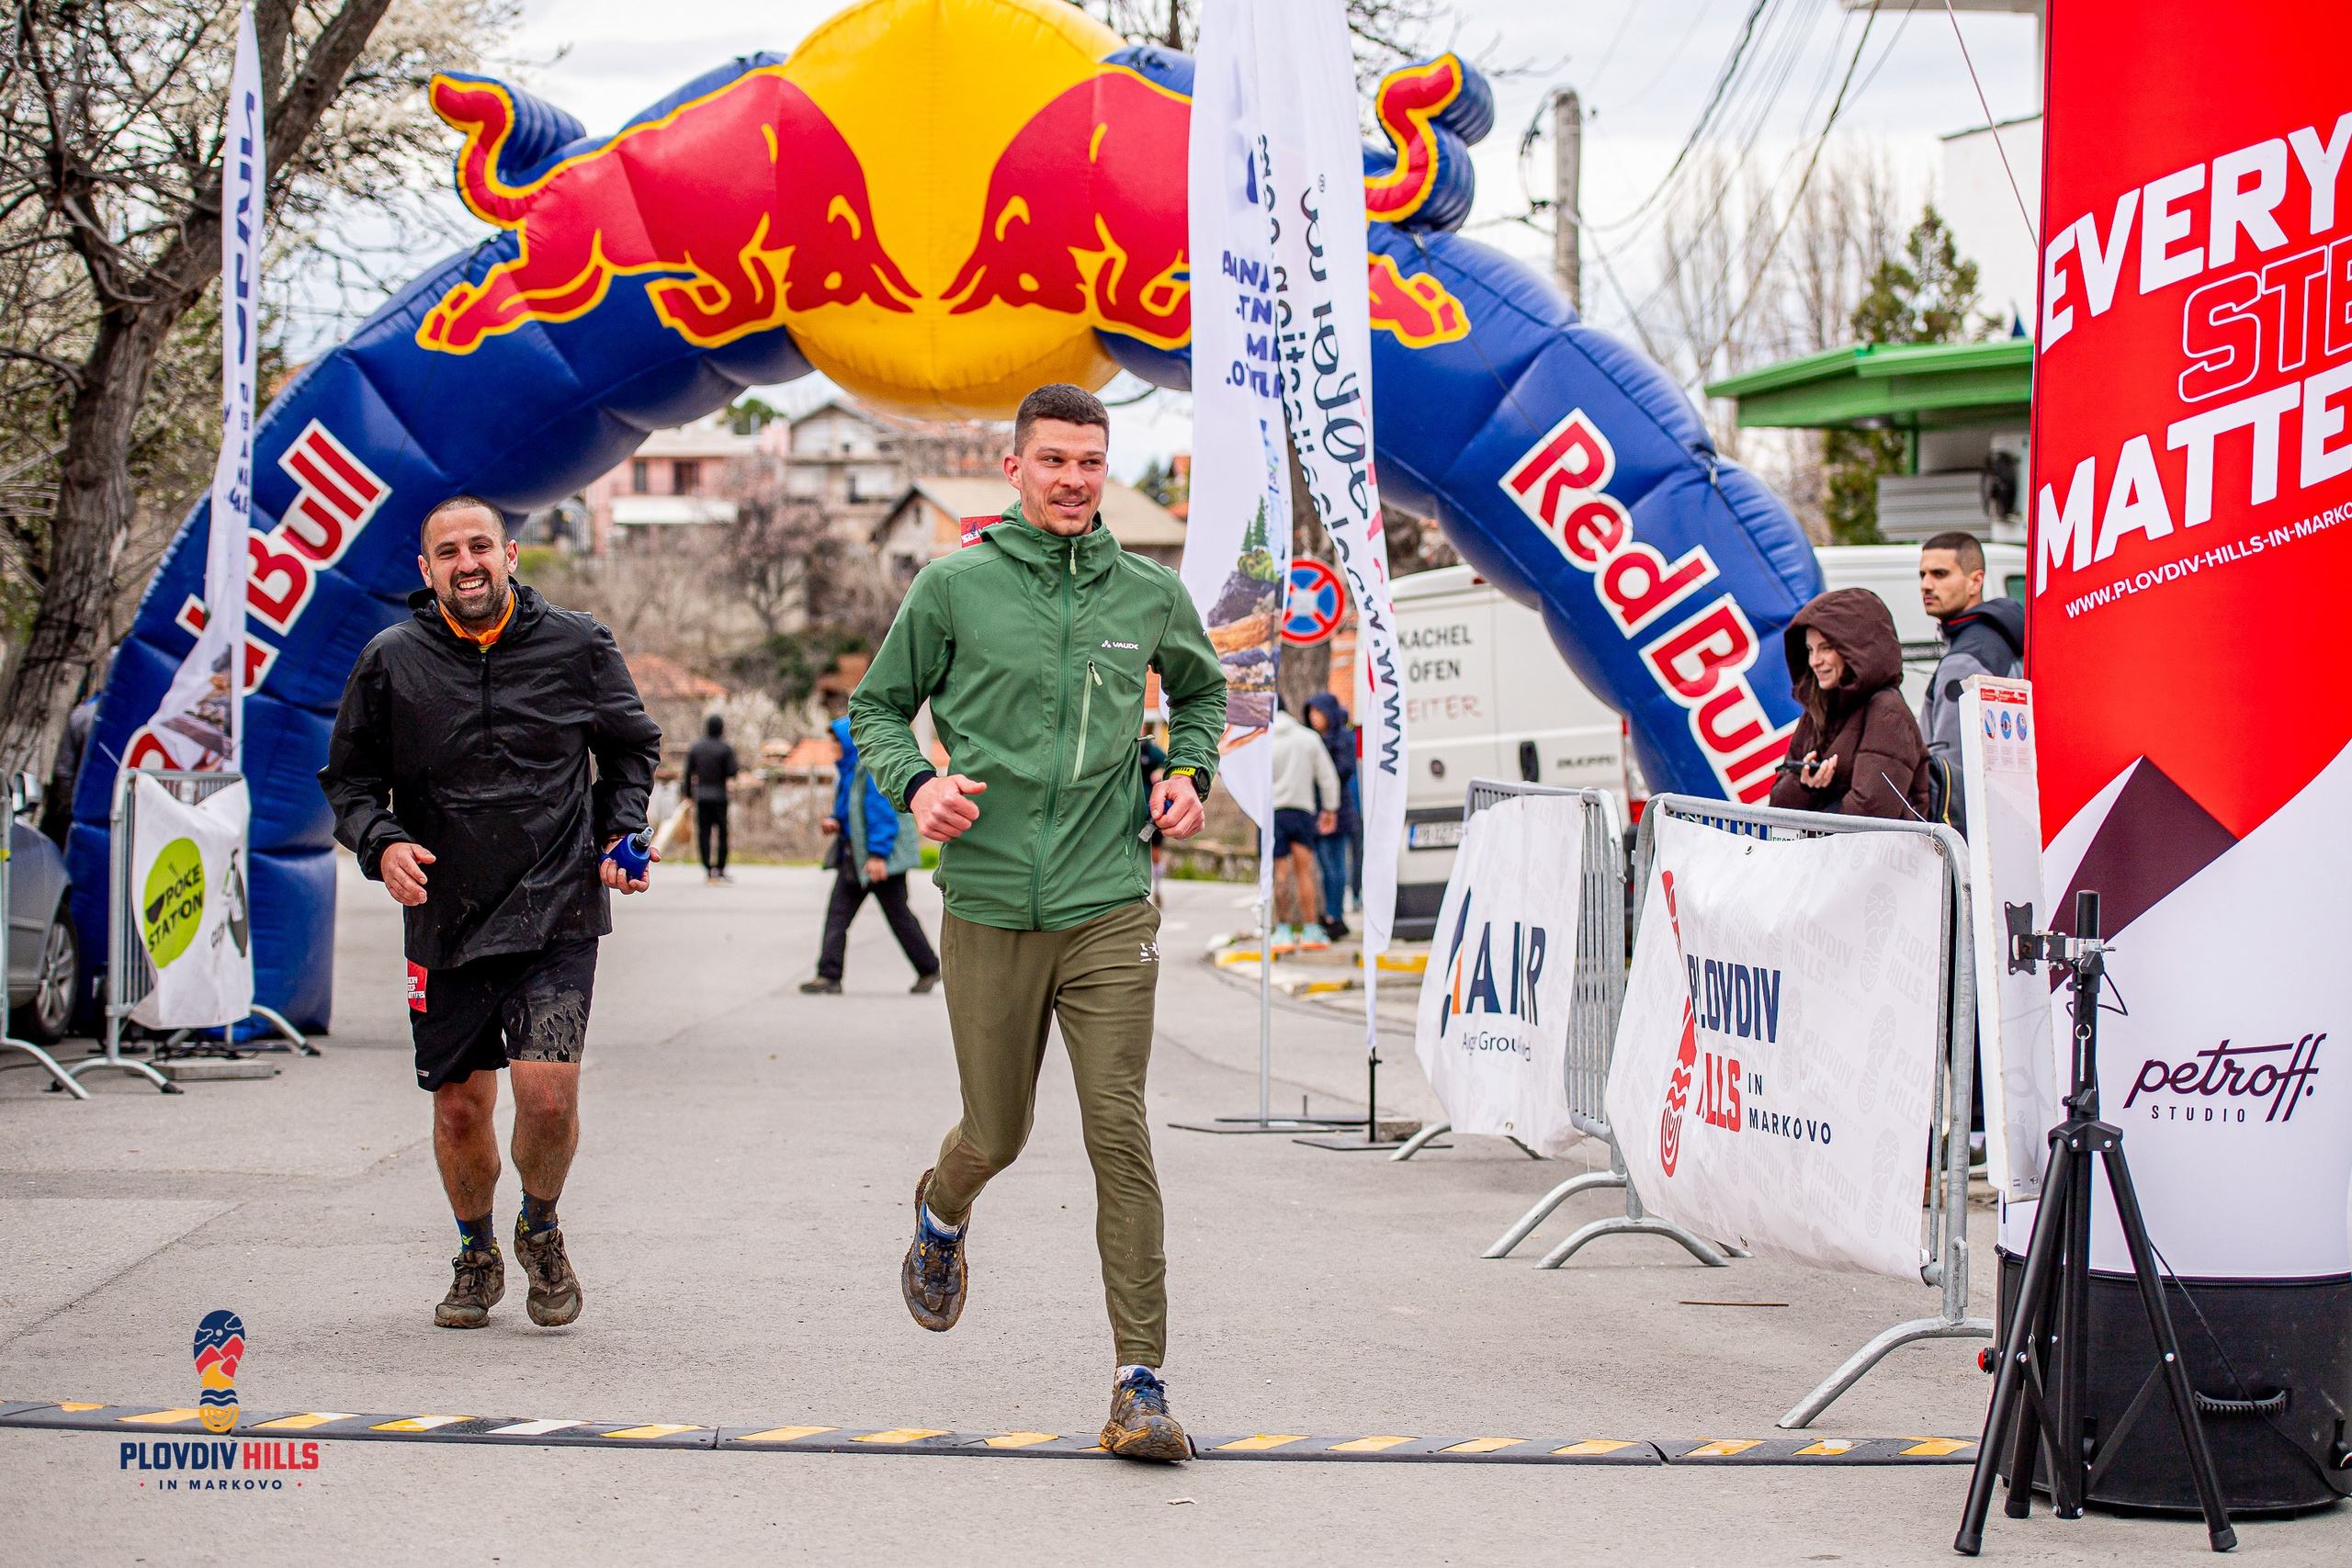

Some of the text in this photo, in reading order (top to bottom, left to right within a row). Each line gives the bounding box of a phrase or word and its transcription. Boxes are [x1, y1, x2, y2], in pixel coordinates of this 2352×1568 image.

[2041, 112, 2352, 355] EVERY
[2035, 363, 2352, 598] MATTE
[244, 423, 387, 632] Bull
[1505, 415, 1713, 632] Red
[1112, 641, 1139, 650] VAUDE
[164, 863, 201, 907] POKE
[148, 890, 203, 953] STATON
[1748, 1072, 1762, 1096] IN
[1749, 1107, 1831, 1145] MARKOVO
[2152, 1105, 2245, 1122] STUDIO
